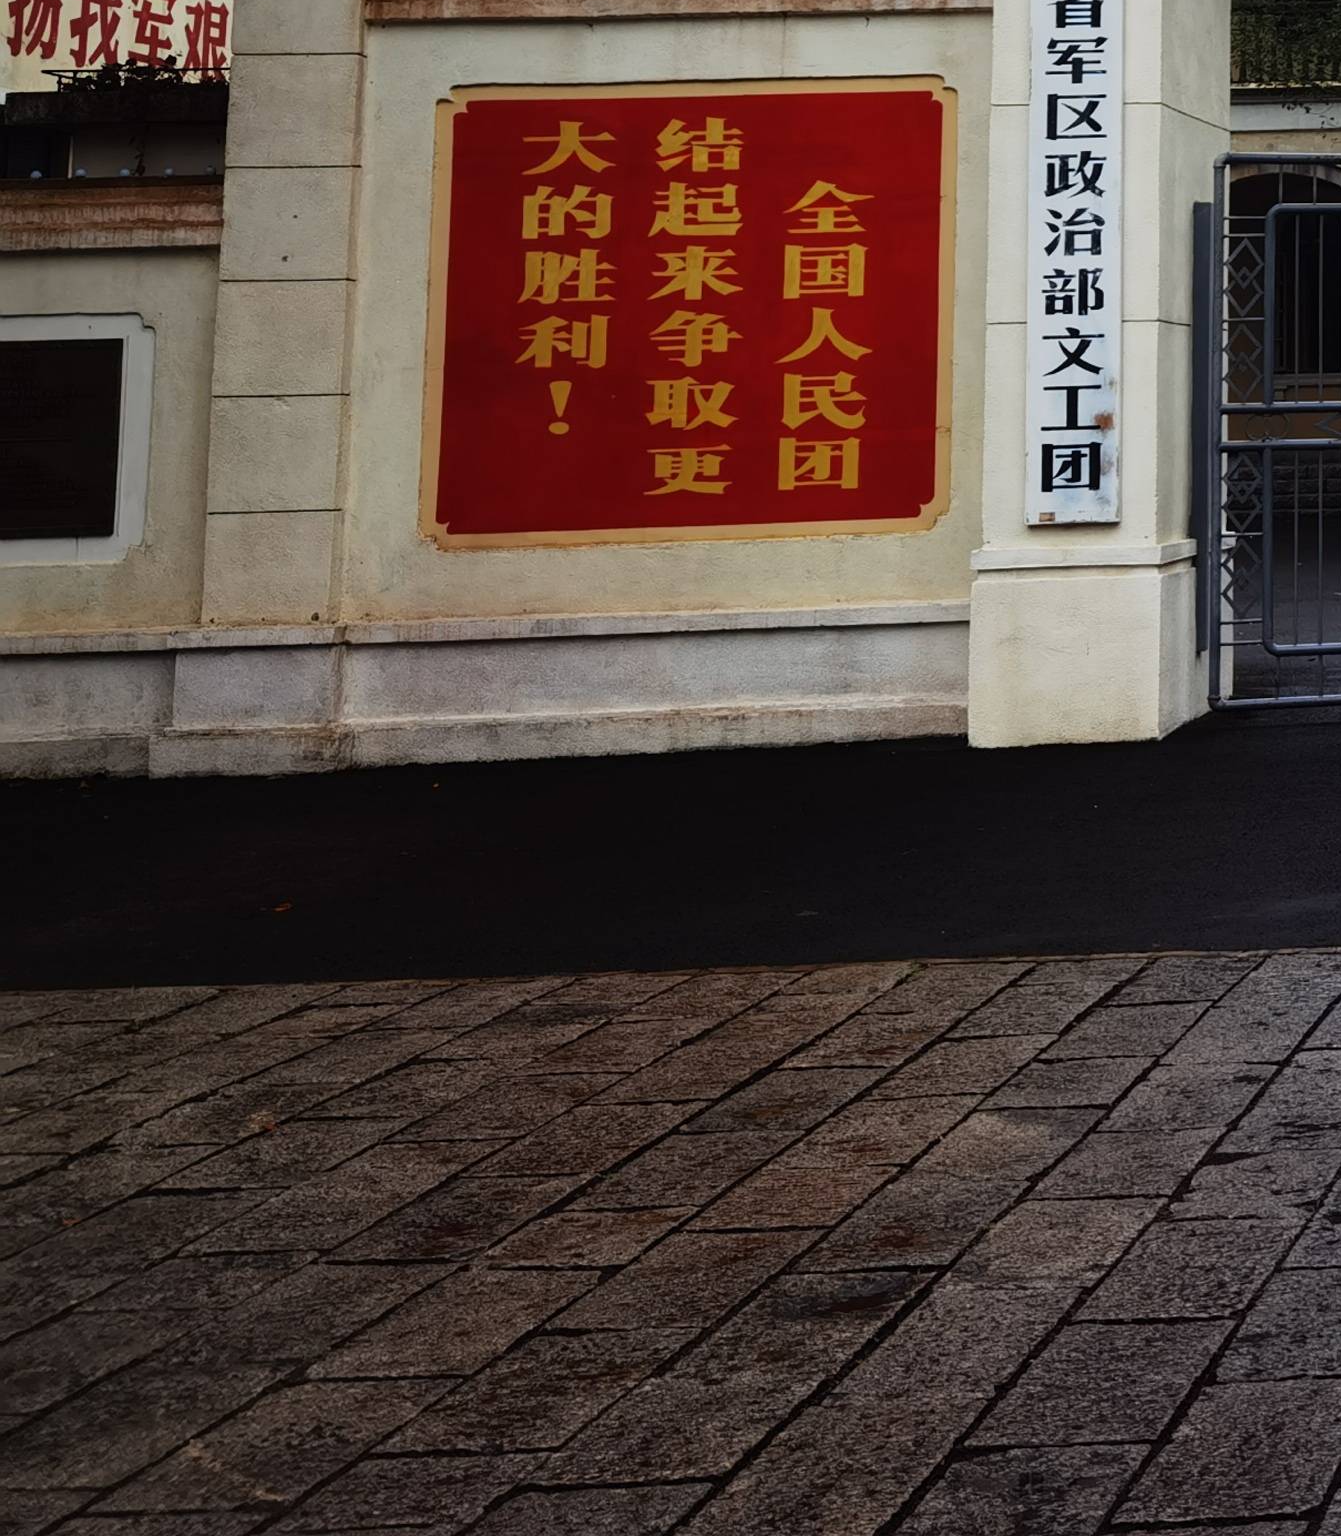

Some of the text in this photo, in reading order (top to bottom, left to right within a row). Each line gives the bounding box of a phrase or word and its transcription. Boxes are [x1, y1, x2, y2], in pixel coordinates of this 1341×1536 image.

[515, 120, 616, 435] 大的胜利!
[644, 117, 743, 495] 结起来争取更
[773, 180, 875, 490] 全国人民团
